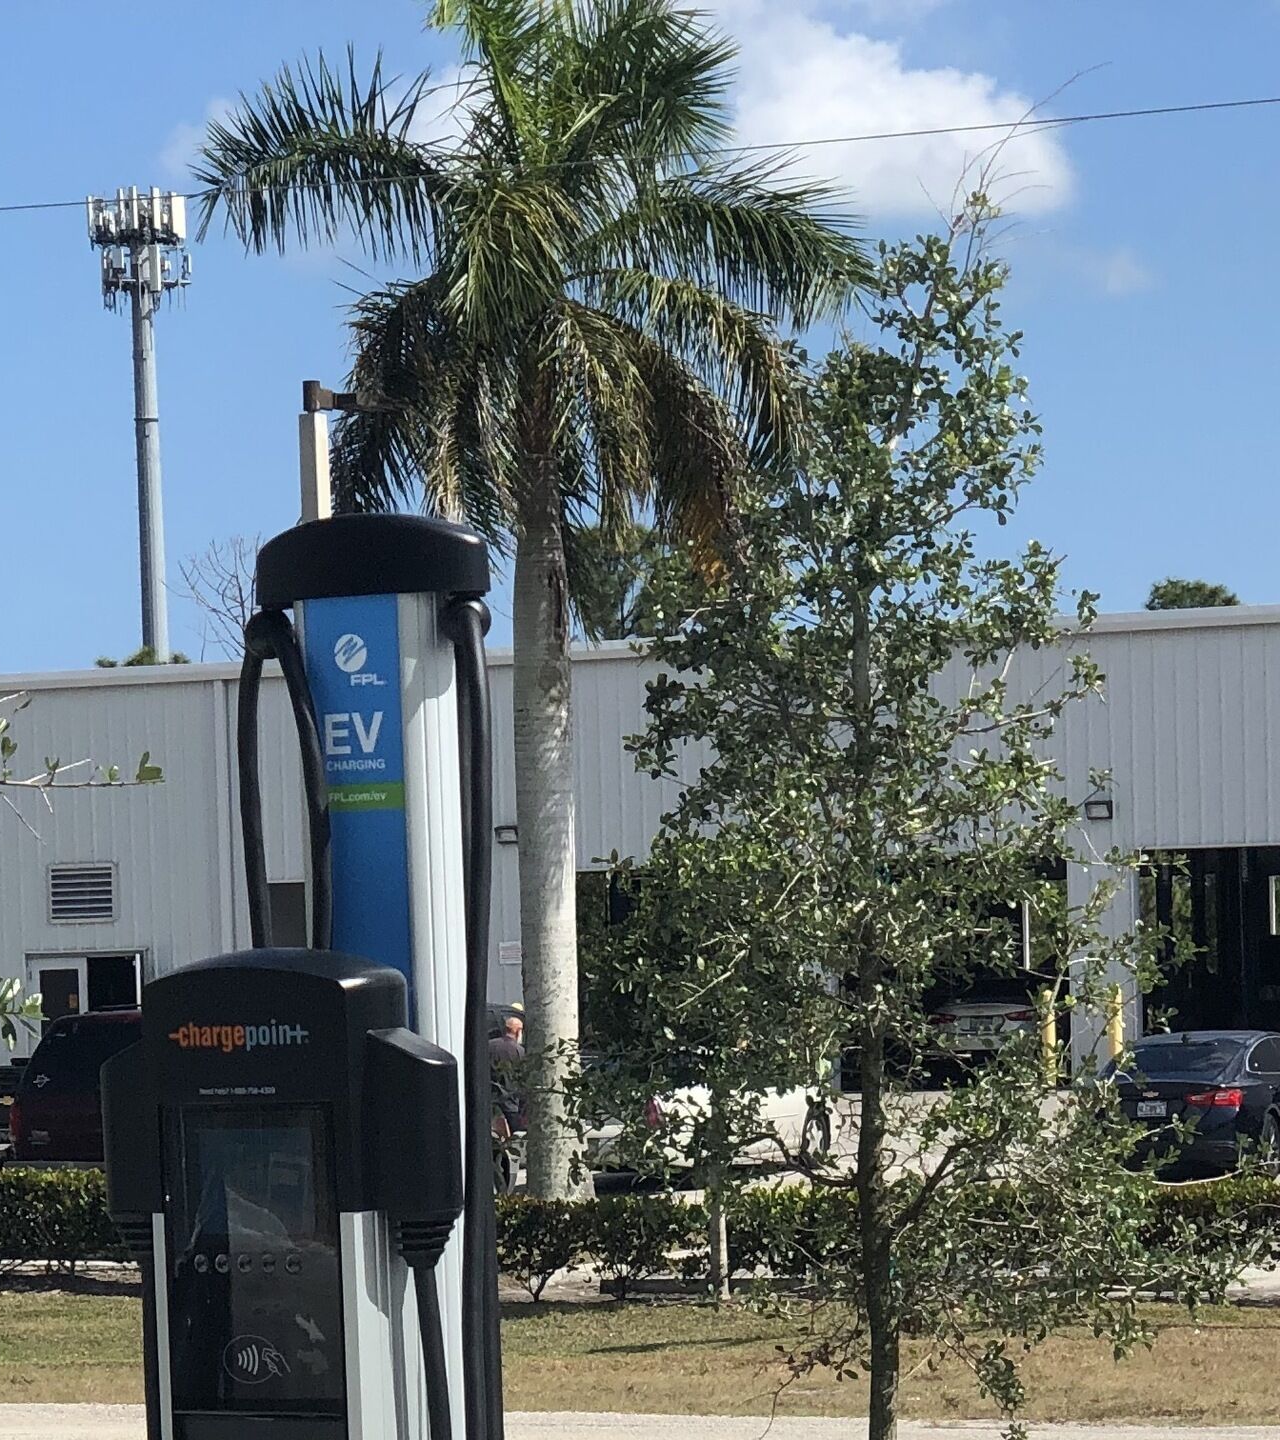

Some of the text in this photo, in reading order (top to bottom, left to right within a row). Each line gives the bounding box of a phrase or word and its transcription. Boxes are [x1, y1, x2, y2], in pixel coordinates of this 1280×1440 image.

[350, 672, 385, 687] FPL
[324, 711, 383, 755] EV
[326, 758, 386, 772] CHARGING
